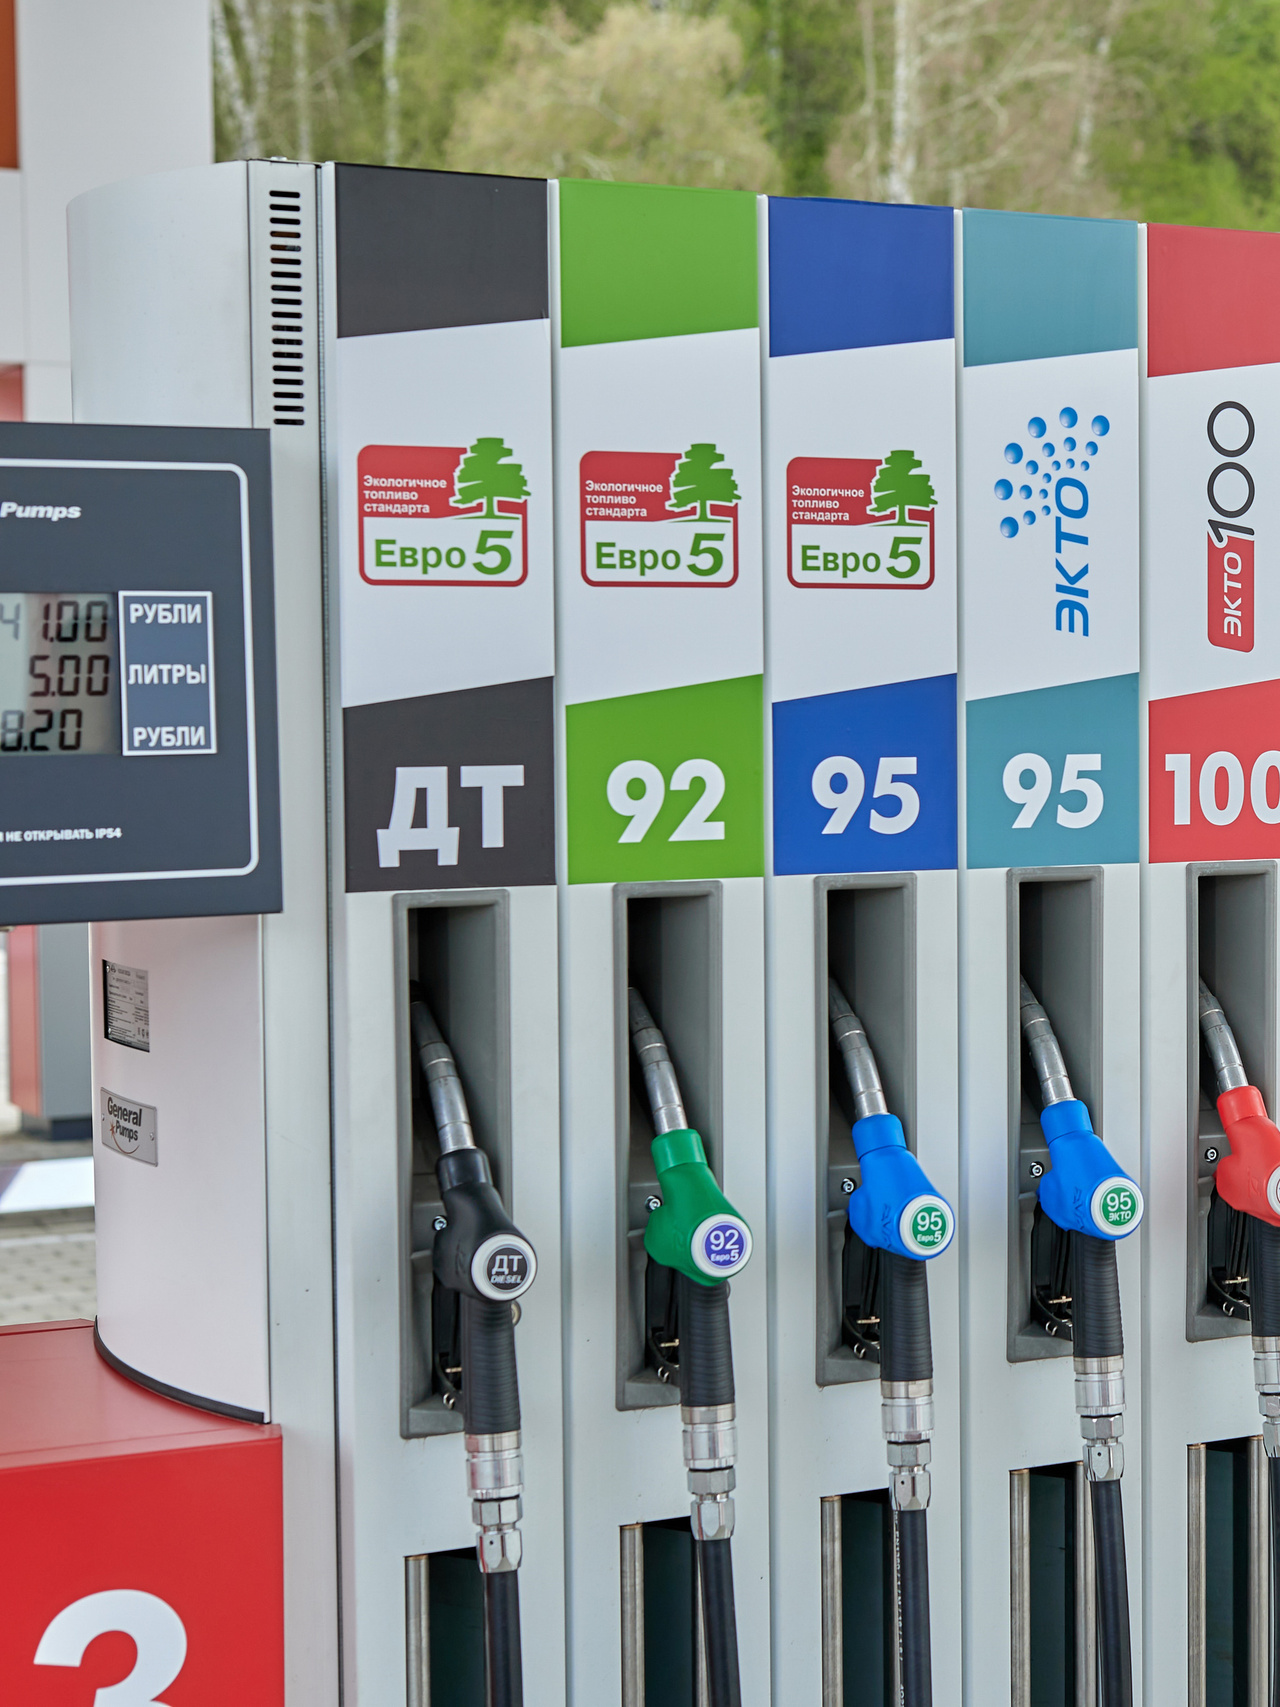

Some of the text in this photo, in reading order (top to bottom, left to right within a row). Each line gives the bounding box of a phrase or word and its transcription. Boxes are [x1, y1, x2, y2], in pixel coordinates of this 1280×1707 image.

[363, 475, 447, 489] Экологичное
[585, 480, 663, 493] Экологичное
[792, 485, 865, 498] Экологичное
[363, 490, 418, 501] топливо
[585, 494, 637, 505] топливо
[792, 499, 840, 509] топливо
[0, 501, 82, 522] Pumps
[364, 503, 431, 515] стандарта
[585, 506, 648, 519] стандарта
[792, 511, 850, 523] стандарта
[375, 530, 514, 575] Евро 5
[595, 533, 726, 577] Евро 5
[801, 536, 923, 579] Евро 5
[1054, 476, 1089, 638] ЭКТО
[129, 603, 202, 624] РУБЛИ
[29, 655, 110, 697] 5.00
[128, 663, 207, 685] ЛИТРЫ
[132, 725, 206, 748] РУБЛИ
[606, 758, 726, 844] 92
[811, 755, 921, 835] 95
[1002, 752, 1105, 829] 95
[376, 764, 525, 868] ДТ
[5, 830, 23, 842] НЕ
[23, 828, 94, 842] ОТКРЫВАТЬ
[108, 1096, 142, 1127] General
[116, 1120, 138, 1143] Pumps
[1106, 1191, 1132, 1212] 95
[917, 1211, 942, 1231] 95
[1108, 1210, 1132, 1222] ЭКТО
[710, 1229, 739, 1251] 92
[491, 1254, 523, 1275] ДТ
[490, 1274, 522, 1284] DIESEL
